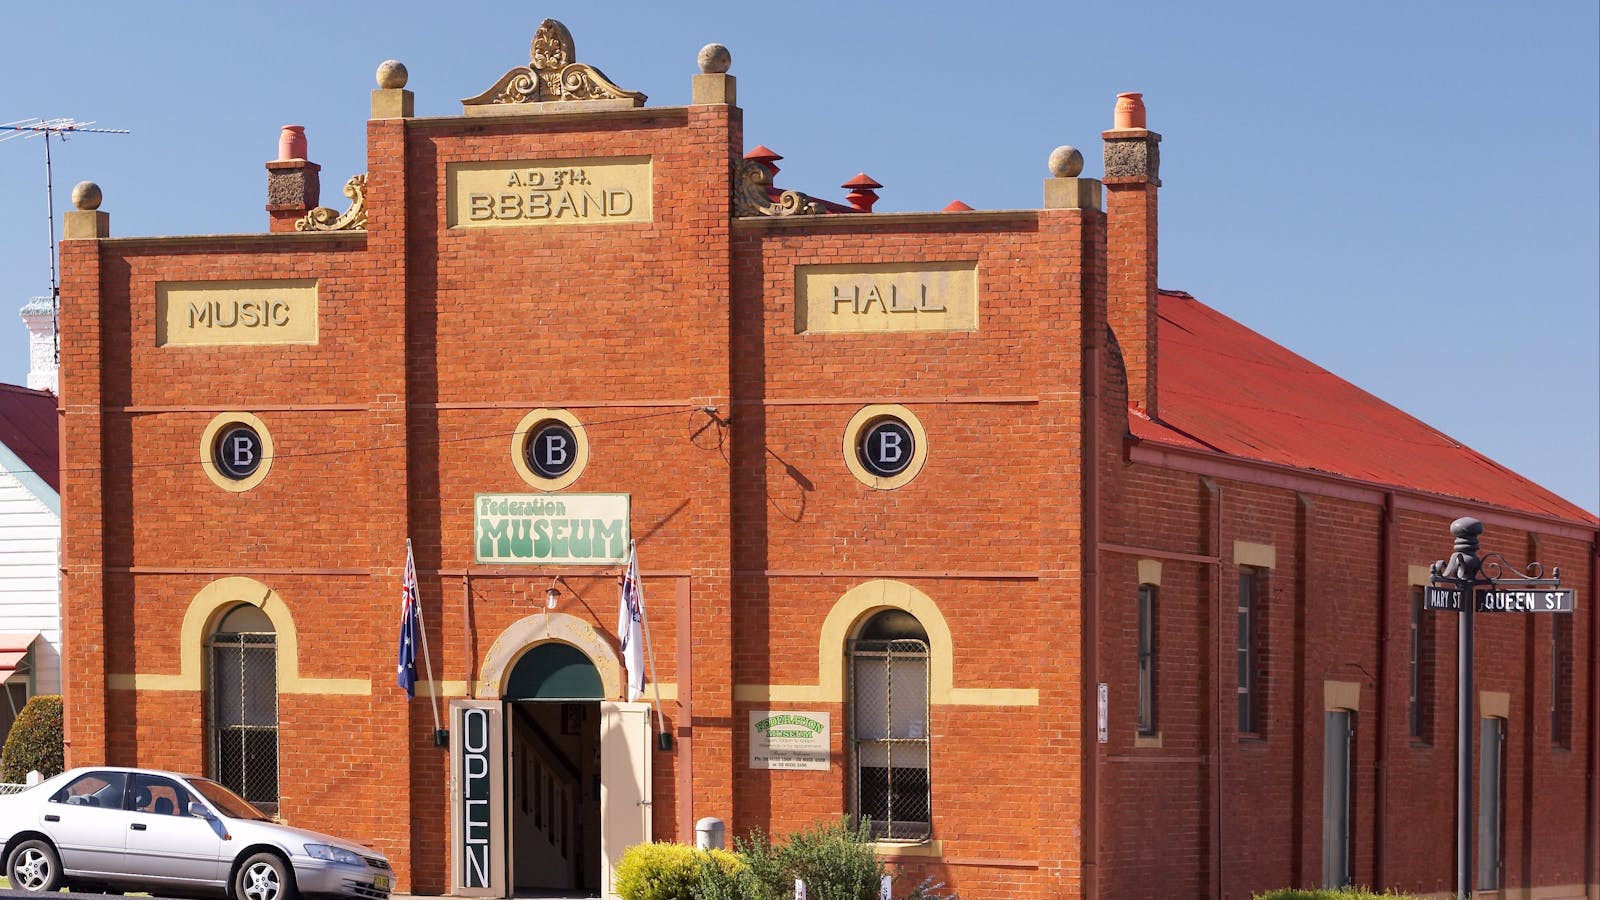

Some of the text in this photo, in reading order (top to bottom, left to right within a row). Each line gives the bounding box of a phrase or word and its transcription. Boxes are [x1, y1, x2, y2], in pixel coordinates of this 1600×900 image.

[187, 299, 290, 328] MUSIC
[832, 283, 947, 315] HALL
[233, 437, 253, 466] B
[546, 435, 567, 465] B
[879, 431, 902, 463] B
[480, 498, 566, 516] Federation
[479, 518, 624, 558] MUSEUM
[1431, 589, 1461, 609] MARY ST
[1485, 591, 1564, 610] QUEEN ST
[754, 714, 825, 735] FEDERATION
[766, 729, 813, 738] MUSEUM
[464, 708, 489, 888] OPEN
